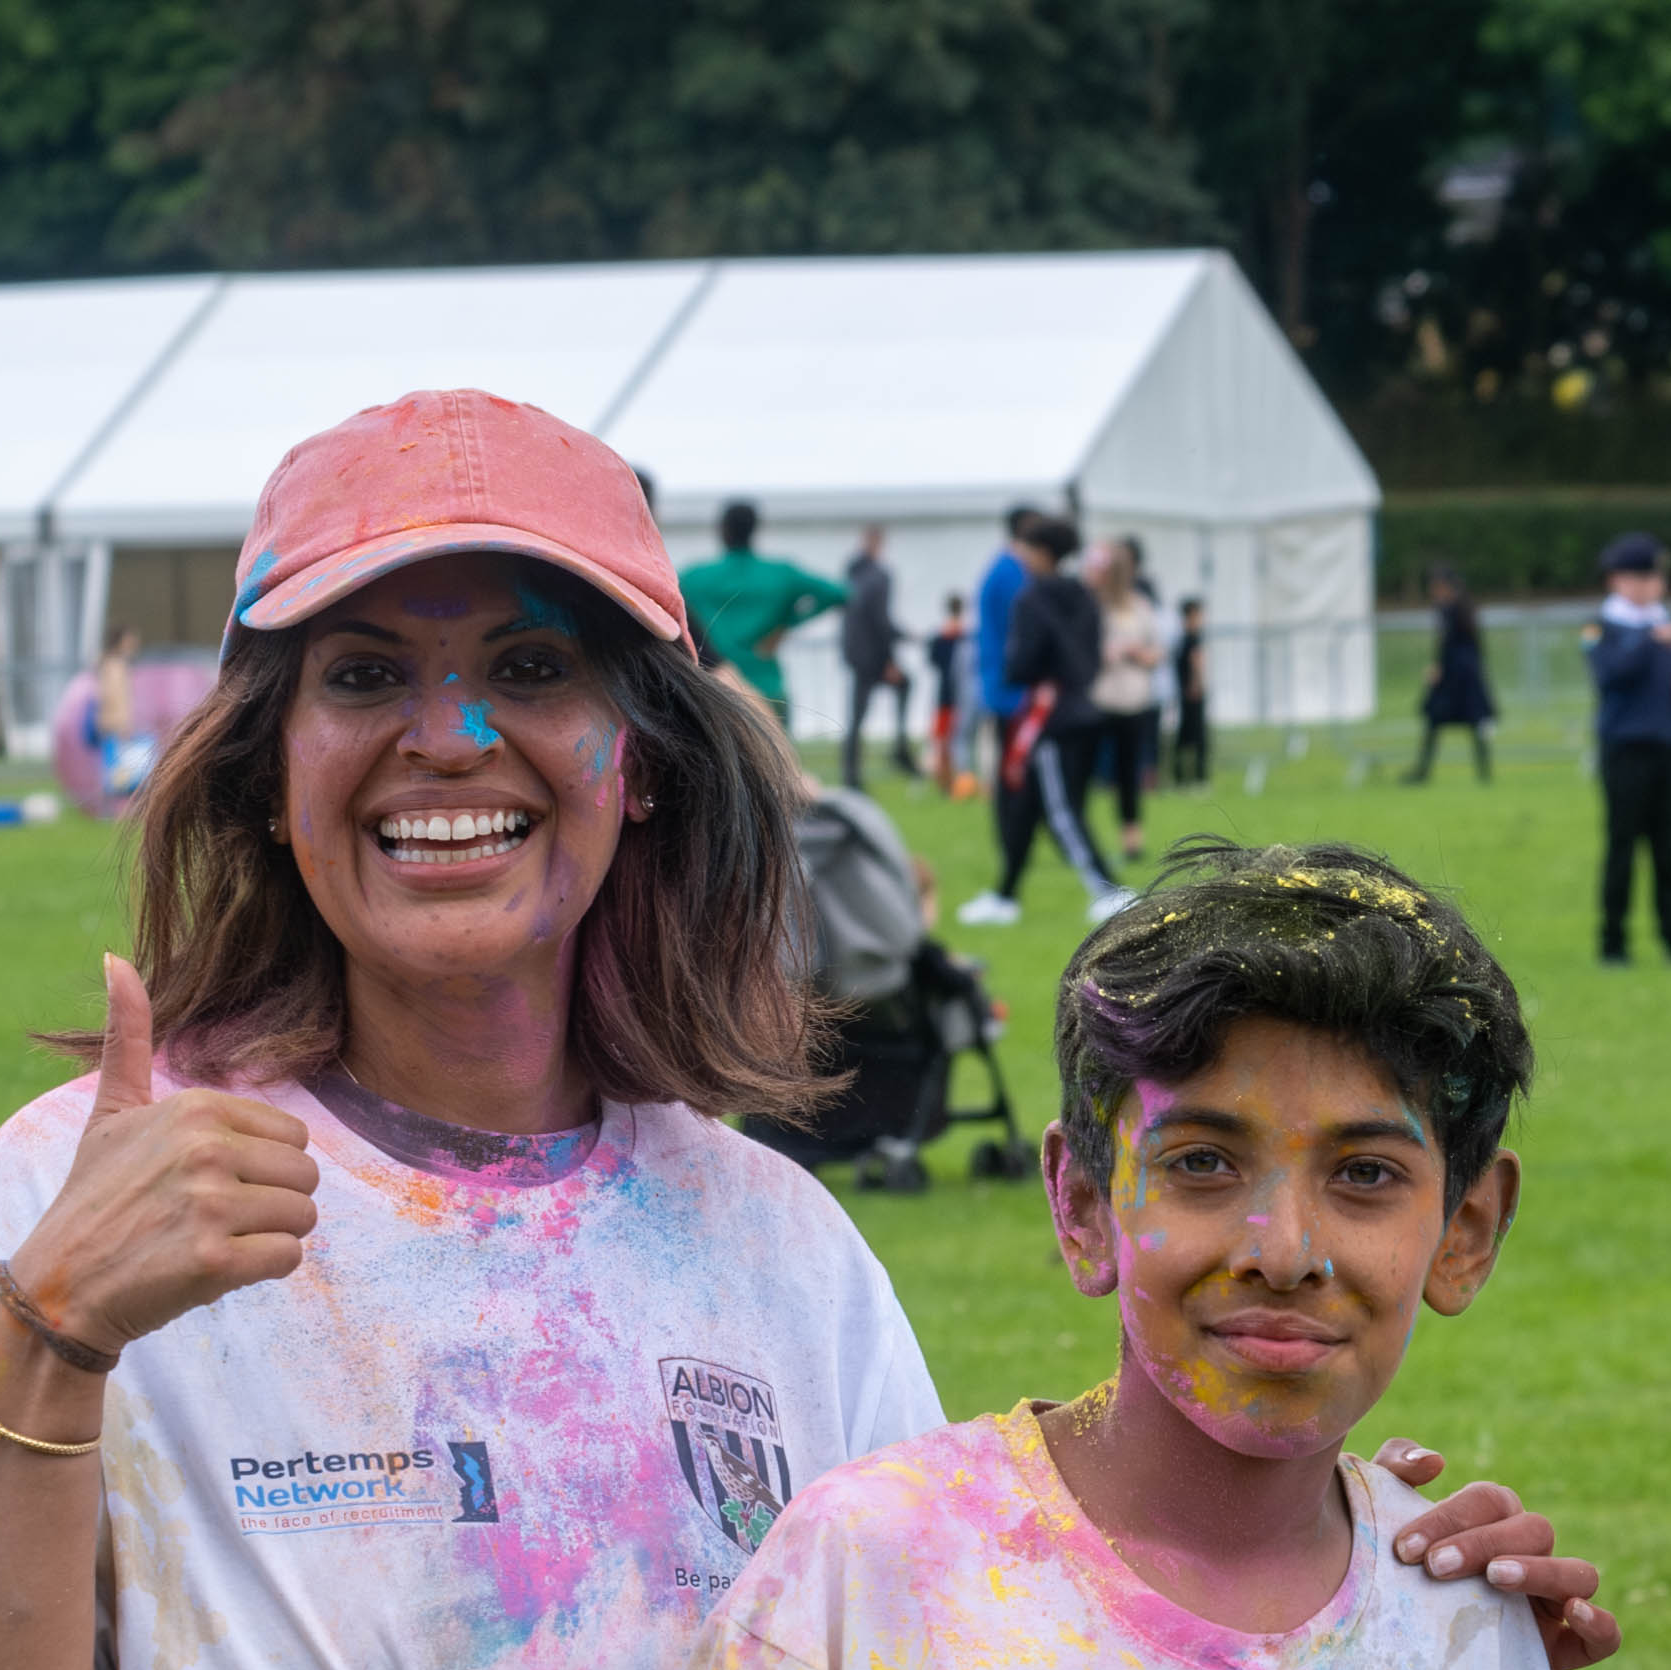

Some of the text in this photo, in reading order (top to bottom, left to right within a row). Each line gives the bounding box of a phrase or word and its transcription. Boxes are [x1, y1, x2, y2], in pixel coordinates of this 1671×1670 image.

[672, 1366, 775, 1422] ALBION
[230, 1449, 435, 1480] Pertemps
[234, 1475, 406, 1508] Network
[241, 1506, 443, 1530] the face of recruitment
[675, 1567, 701, 1588] Be
